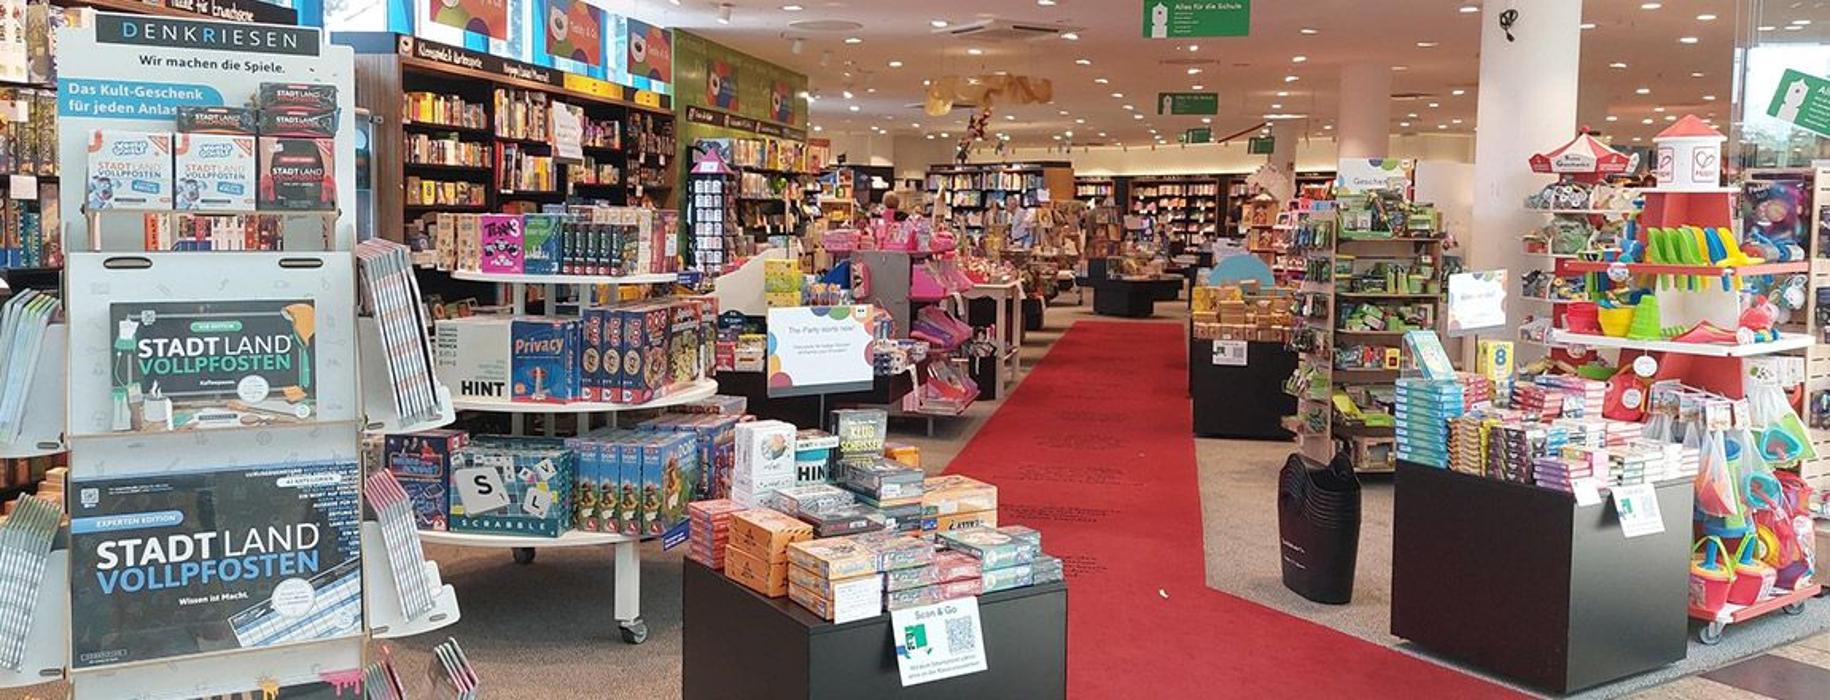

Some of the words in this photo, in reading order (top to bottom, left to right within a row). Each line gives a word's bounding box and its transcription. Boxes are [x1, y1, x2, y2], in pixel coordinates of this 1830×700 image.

[123, 21, 298, 49] DENKRIESEN
[139, 55, 162, 66] Wir
[166, 56, 218, 69] machen
[221, 59, 241, 71] die
[244, 60, 286, 74] Spiele.
[68, 82, 97, 95] Das
[100, 83, 204, 100] Kult-Geschenk
[68, 99, 89, 112] für
[93, 100, 135, 115] jeden
[98, 162, 131, 170] STADT
[185, 164, 216, 172] STADT
[272, 167, 299, 175] STADT
[299, 167, 324, 176] LAND
[98, 170, 162, 179] VOLLPFOSTEN
[186, 171, 246, 180] VOLLPFOSTEN
[802, 326, 820, 334] Party
[138, 337, 219, 359] STADT
[224, 334, 292, 355] LAND
[515, 337, 565, 355] Privacy
[138, 354, 291, 376] VOLLPFOSTEN
[1494, 349, 1507, 366] 8
[461, 380, 505, 397] HINT
[850, 425, 875, 439] KLUG
[797, 465, 825, 481] HIN
[474, 475, 493, 495] S
[532, 495, 540, 510] L
[96, 517, 140, 528] EXPERTEN
[141, 514, 176, 524] EDITION
[461, 518, 546, 530] SCRABBLE
[96, 531, 217, 570] STADT
[224, 522, 320, 557] LAND
[96, 550, 319, 594] VOLLPFOSTEN
[178, 596, 209, 606] Wissen
[210, 594, 220, 602] ist
[221, 591, 249, 601] Macht.
[914, 609, 936, 620] Scan
[937, 607, 943, 616] &
[944, 605, 958, 615] Go
